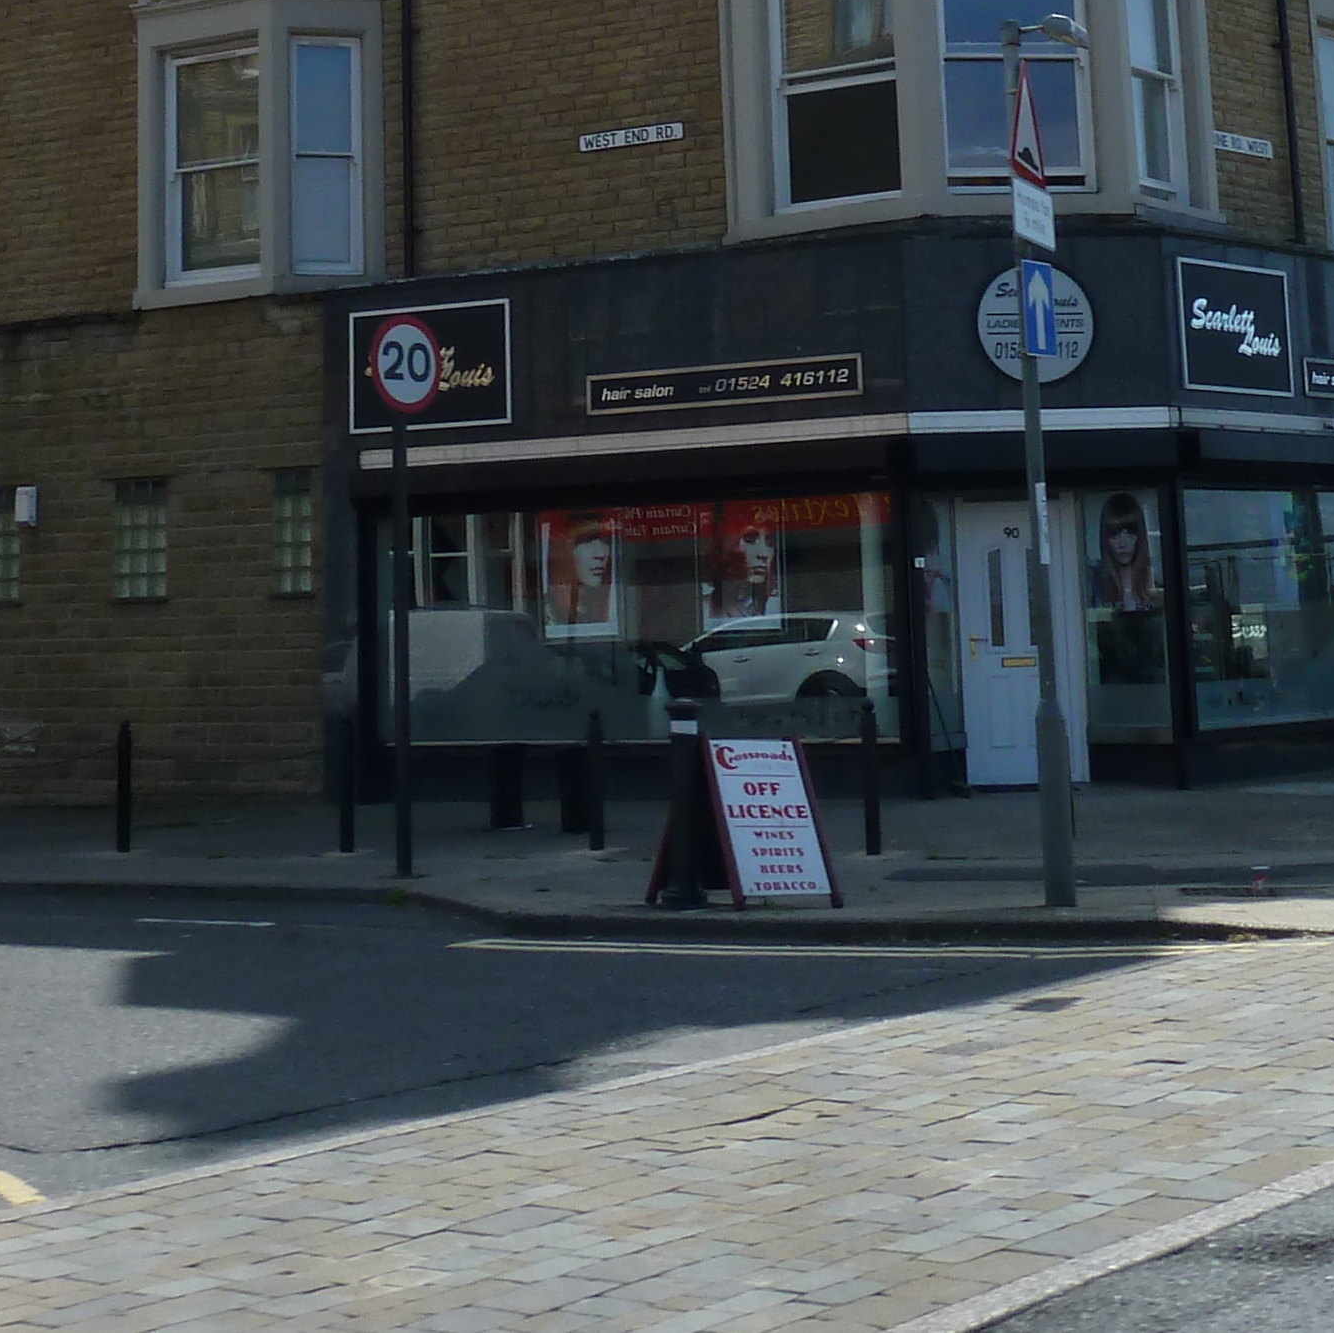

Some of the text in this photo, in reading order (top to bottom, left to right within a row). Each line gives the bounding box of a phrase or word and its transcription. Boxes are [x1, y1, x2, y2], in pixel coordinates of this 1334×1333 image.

[584, 125, 677, 148] WEST END RD.
[1190, 297, 1255, 333] Scarlett
[987, 318, 1084, 329] LADIE ENTS
[1238, 323, 1282, 357] Louis
[382, 341, 431, 382] 20
[602, 387, 630, 401] hair
[634, 384, 674, 399] salon
[715, 375, 770, 393] 01524
[780, 368, 849, 387] 416112
[1312, 371, 1330, 385] hair
[1003, 527, 1020, 538] 90
[716, 746, 794, 770] Crossroads
[743, 781, 780, 796] OFF
[727, 804, 809, 820] LICENCE
[753, 830, 795, 840] WINES
[751, 847, 805, 857] SPIRITS
[760, 864, 804, 874] BEERS
[754, 881, 817, 892] TOBACCO
